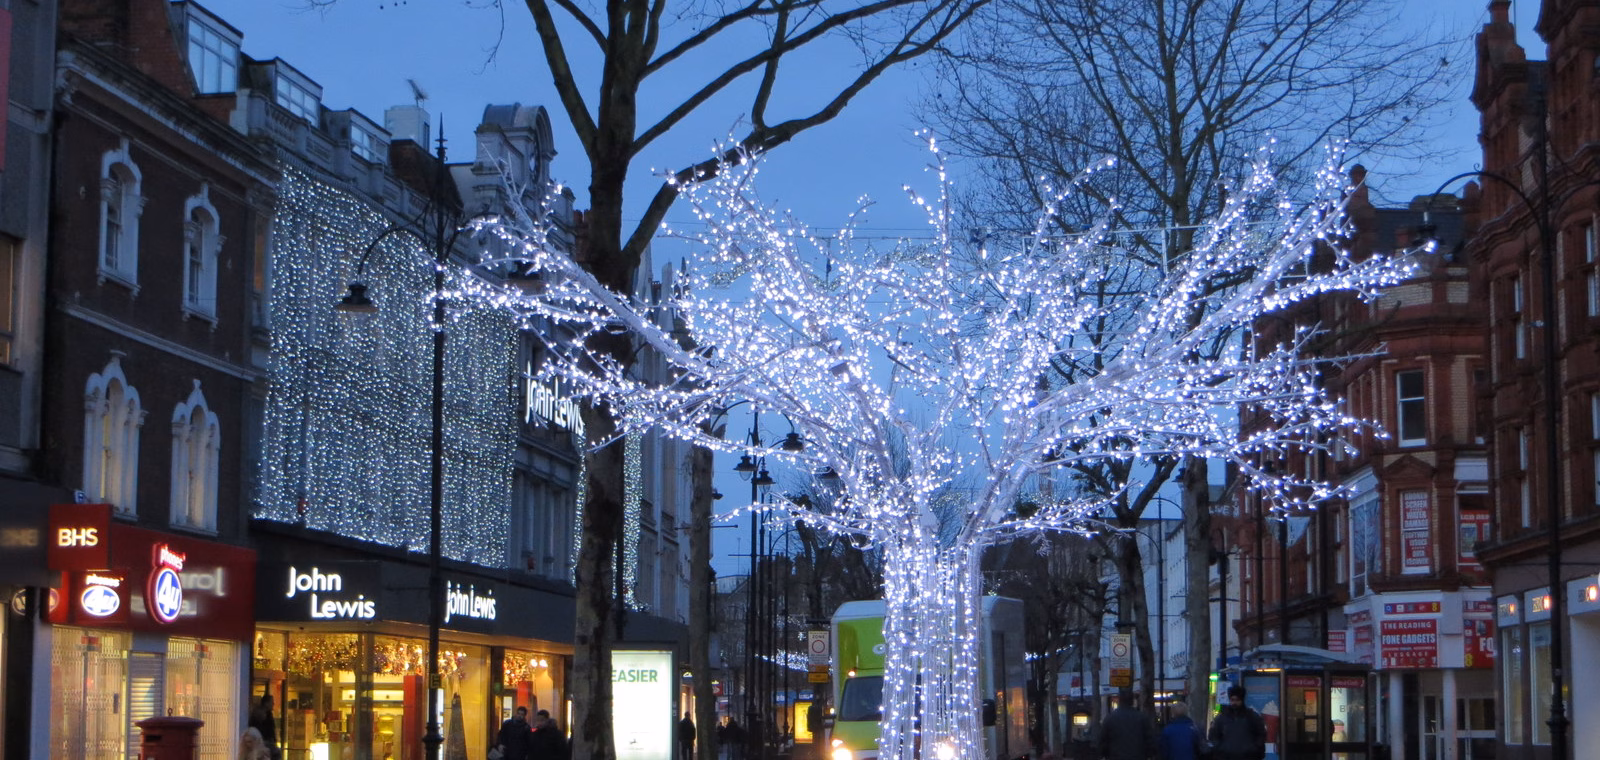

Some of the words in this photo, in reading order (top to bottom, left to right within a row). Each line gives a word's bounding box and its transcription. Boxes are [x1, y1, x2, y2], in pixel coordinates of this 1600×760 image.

[58, 528, 98, 546] BHS
[286, 566, 342, 598] John
[158, 573, 180, 614] 4u
[444, 580, 468, 623] John
[470, 584, 496, 620] Lewis
[311, 594, 376, 618] Lewis
[1398, 621, 1432, 629] READING
[1382, 634, 1400, 645] FONE
[1401, 633, 1436, 644] GADGETS
[611, 669, 658, 682] EASIER
